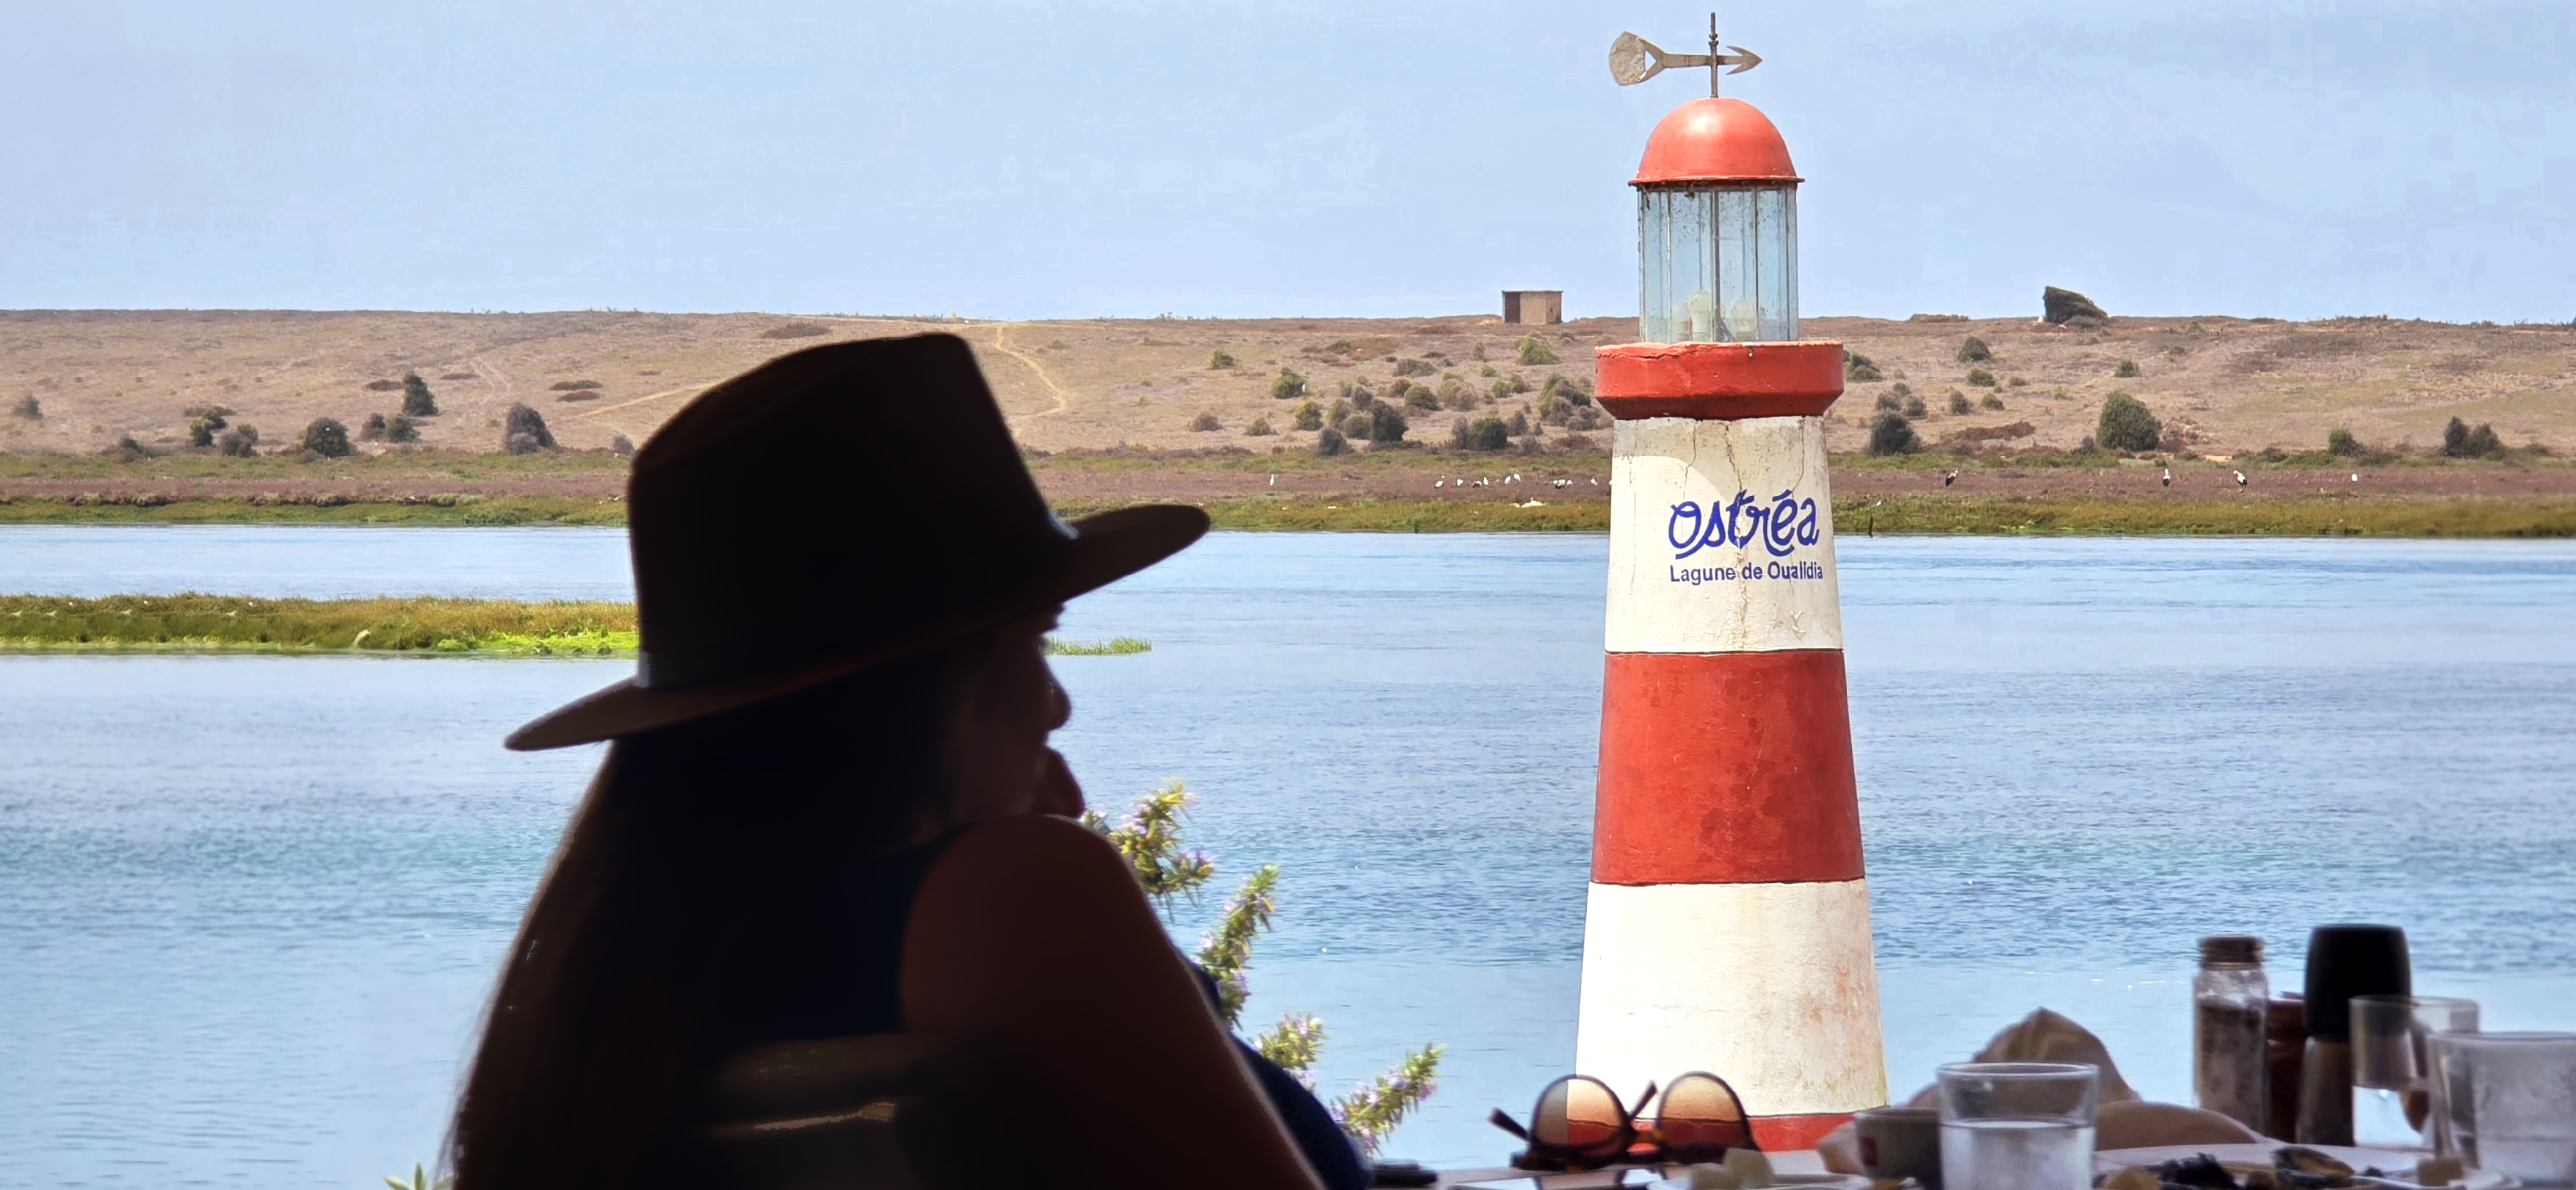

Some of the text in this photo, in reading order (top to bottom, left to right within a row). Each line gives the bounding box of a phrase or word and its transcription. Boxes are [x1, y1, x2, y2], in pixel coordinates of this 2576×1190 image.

[1671, 561, 1823, 585] Lagune de Oualidia
